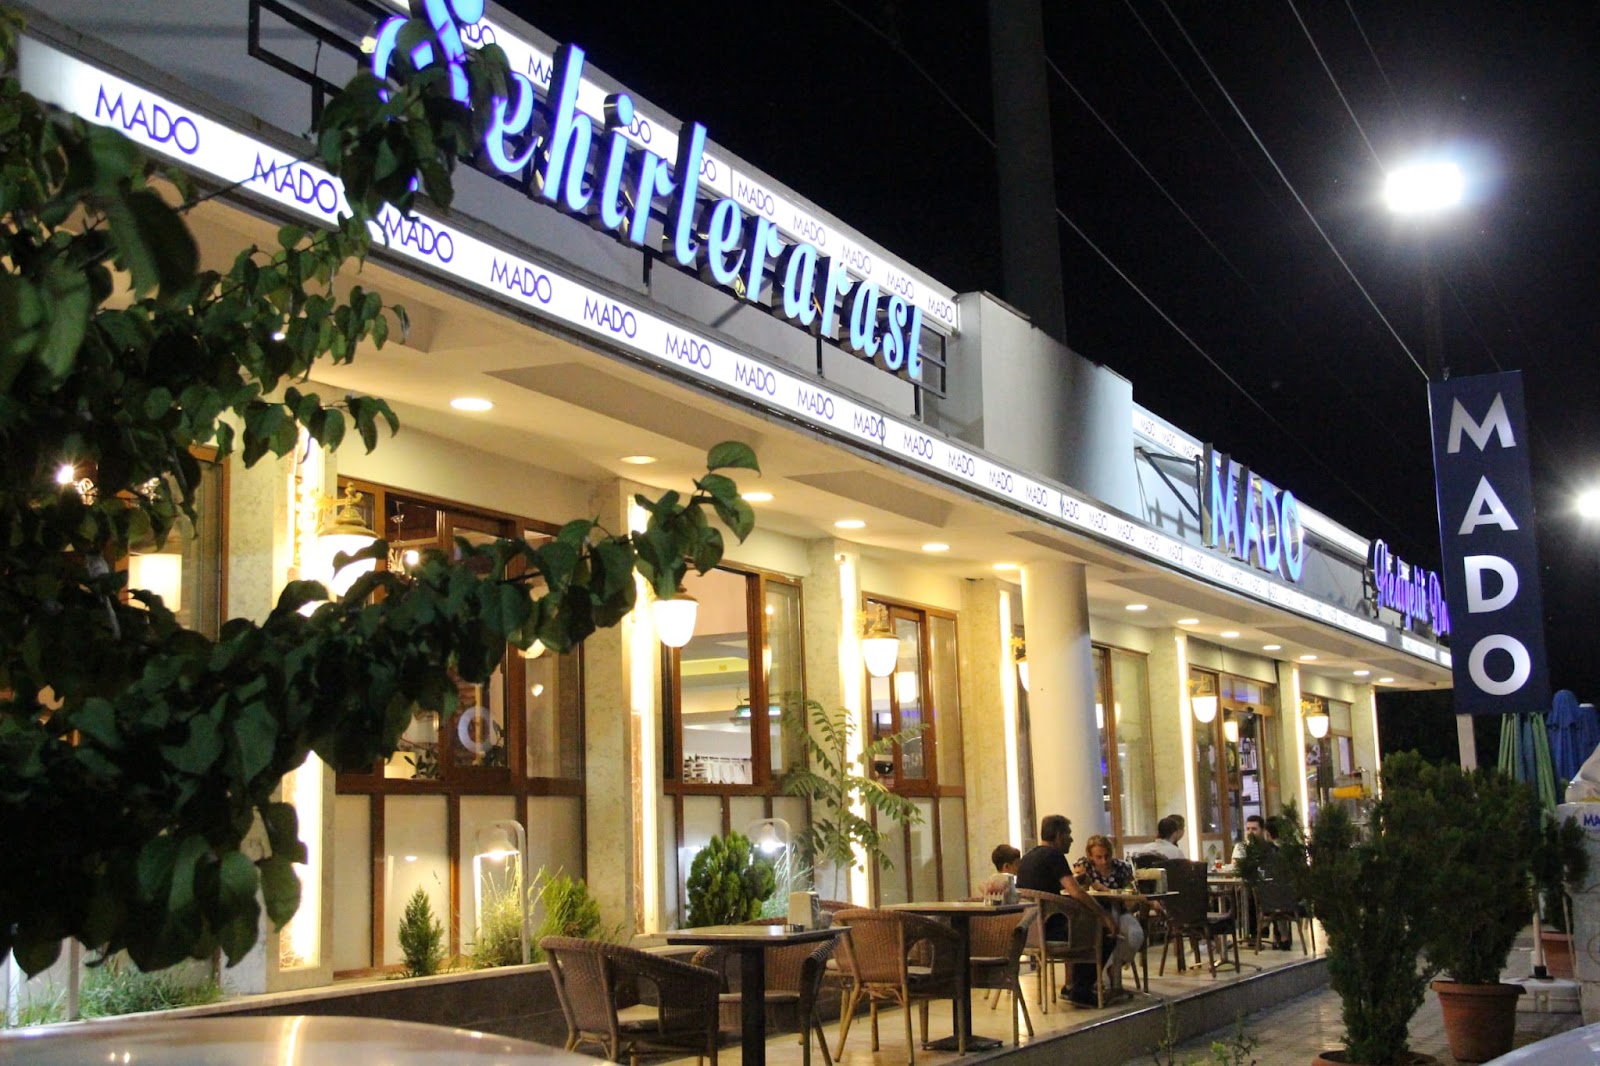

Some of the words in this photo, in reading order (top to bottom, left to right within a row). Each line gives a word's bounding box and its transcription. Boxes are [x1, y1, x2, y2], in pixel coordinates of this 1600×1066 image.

[95, 84, 199, 154] MADO
[252, 152, 338, 214] MADO
[384, 207, 454, 263] MADO
[490, 256, 552, 303] MADO
[583, 296, 637, 339] MADO
[665, 332, 712, 370] MADO
[735, 360, 776, 396] MADO
[797, 386, 835, 420] MADO
[854, 411, 887, 442] MADO
[903, 431, 934, 460] MADO
[948, 449, 976, 478] MADO
[989, 468, 1014, 493] MADO
[1025, 484, 1048, 508] MADO
[738, 179, 774, 216] MADO
[793, 213, 826, 247] MADO
[842, 244, 872, 275] MADO
[887, 271, 915, 300] MADO
[928, 296, 953, 323] MADO
[1210, 449, 1305, 582] MADO
[1447, 392, 1532, 697] MADO
